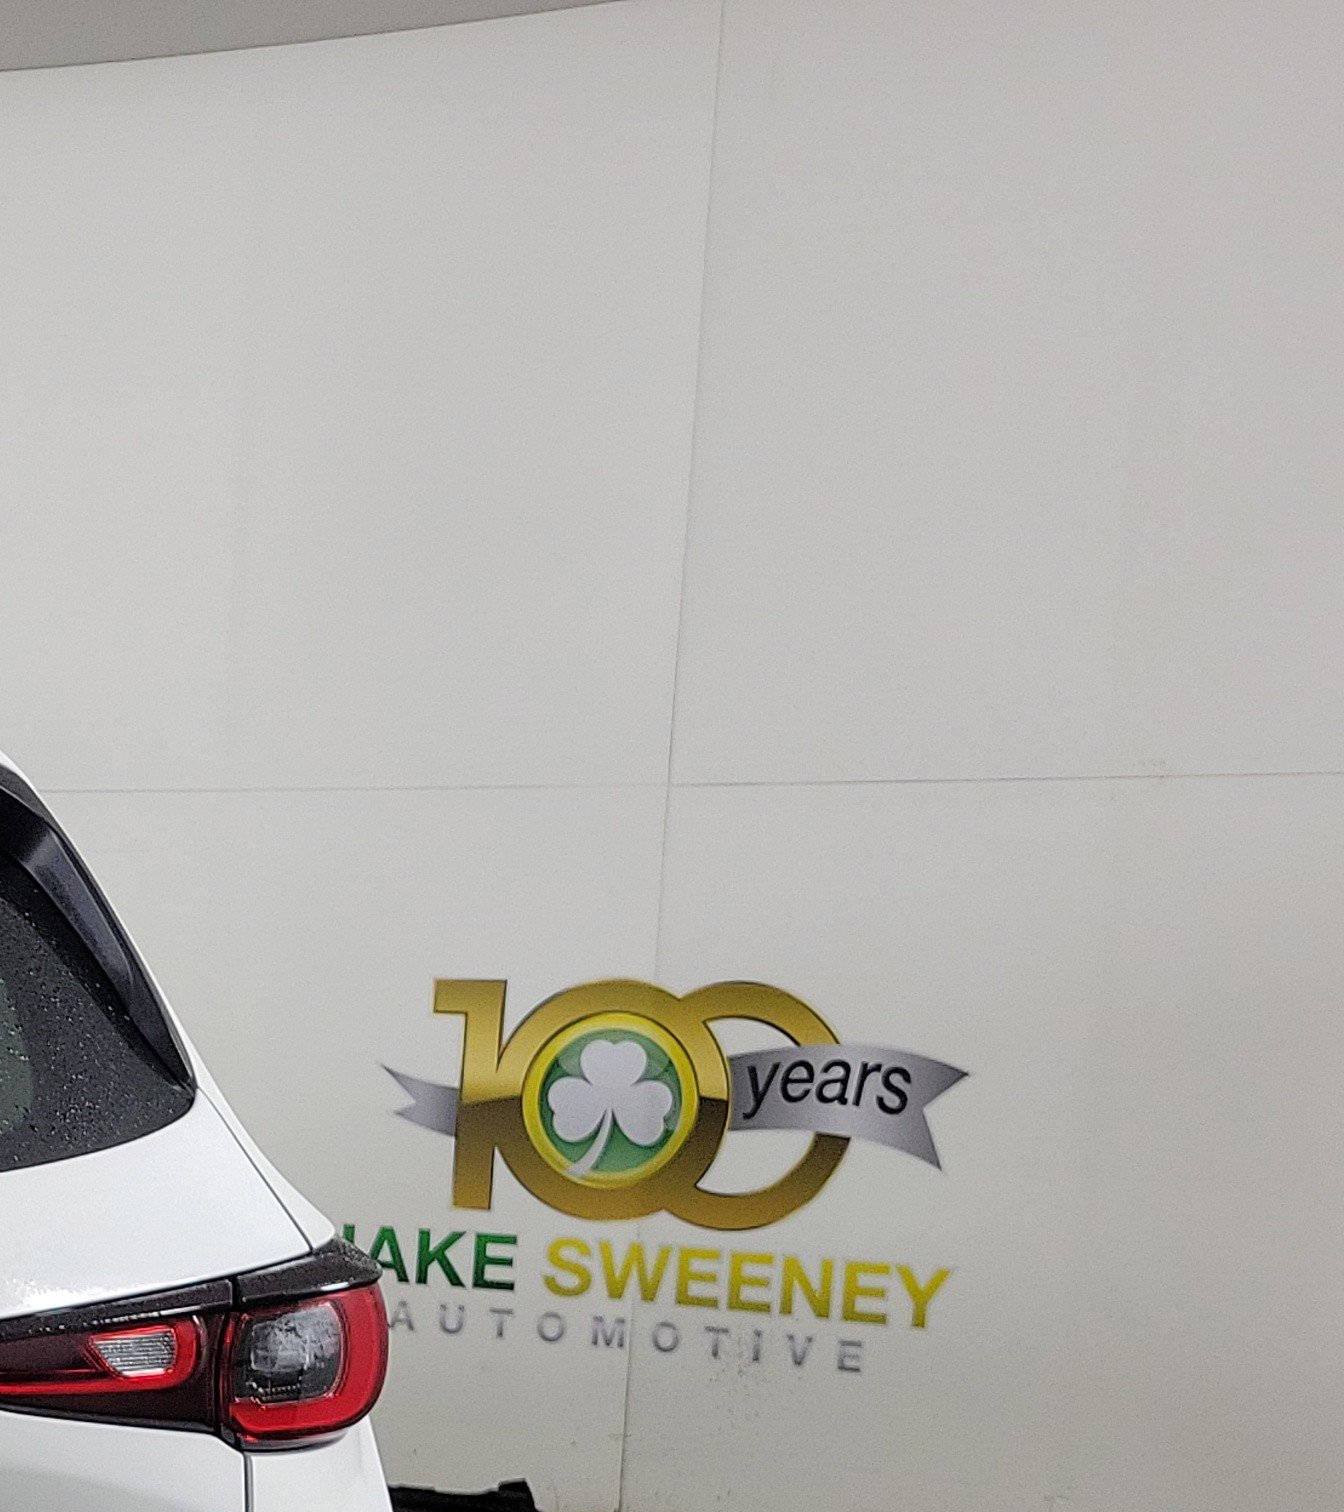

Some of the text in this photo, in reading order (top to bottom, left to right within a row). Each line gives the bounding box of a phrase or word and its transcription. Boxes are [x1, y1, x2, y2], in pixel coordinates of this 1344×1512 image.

[433, 978, 851, 1231] 100
[741, 1056, 913, 1120] years
[343, 1223, 952, 1329] AKE SWEENEY
[388, 1299, 866, 1375] AUTOMOTIVE
